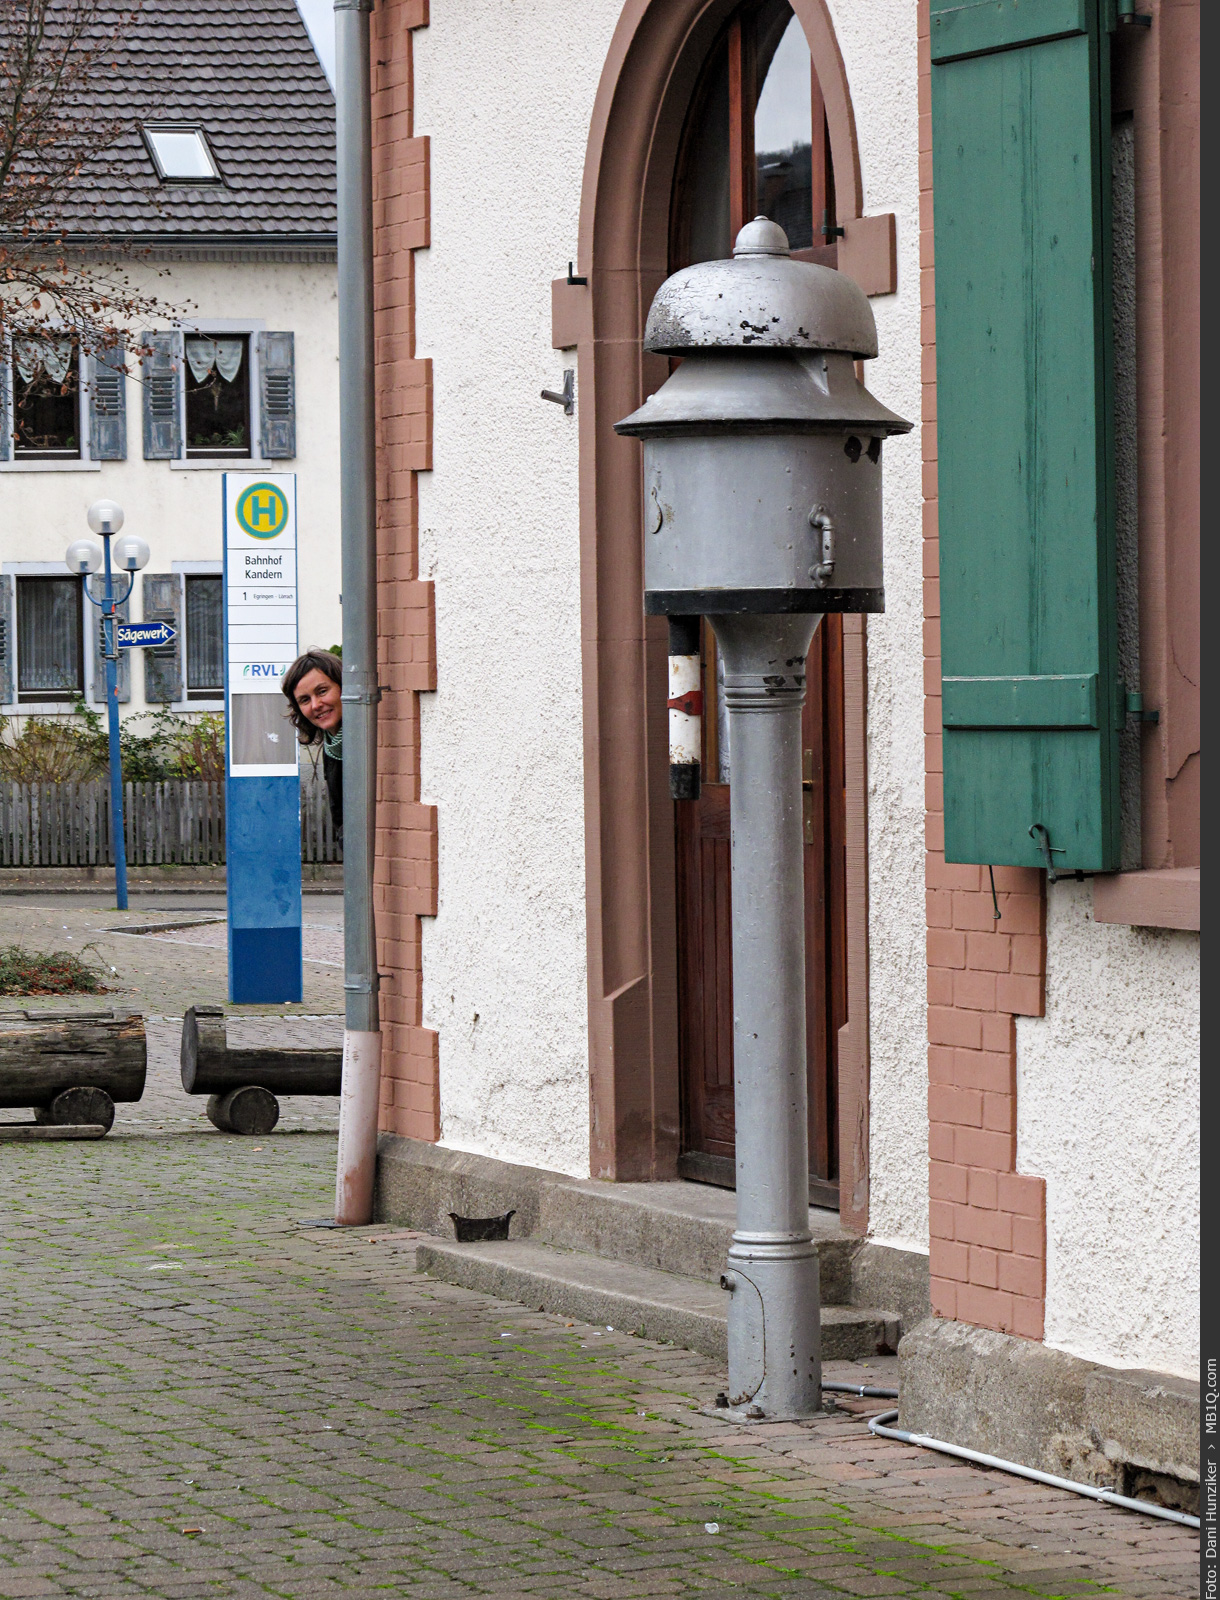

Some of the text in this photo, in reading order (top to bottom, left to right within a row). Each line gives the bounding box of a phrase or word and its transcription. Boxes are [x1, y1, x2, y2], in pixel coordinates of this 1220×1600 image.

[252, 495, 276, 526] H
[245, 555, 282, 565] Bahnhof
[245, 569, 283, 579] Kandern
[243, 591, 247, 601] 1
[117, 625, 169, 644] Sägewerk
[251, 664, 279, 676] RVL
